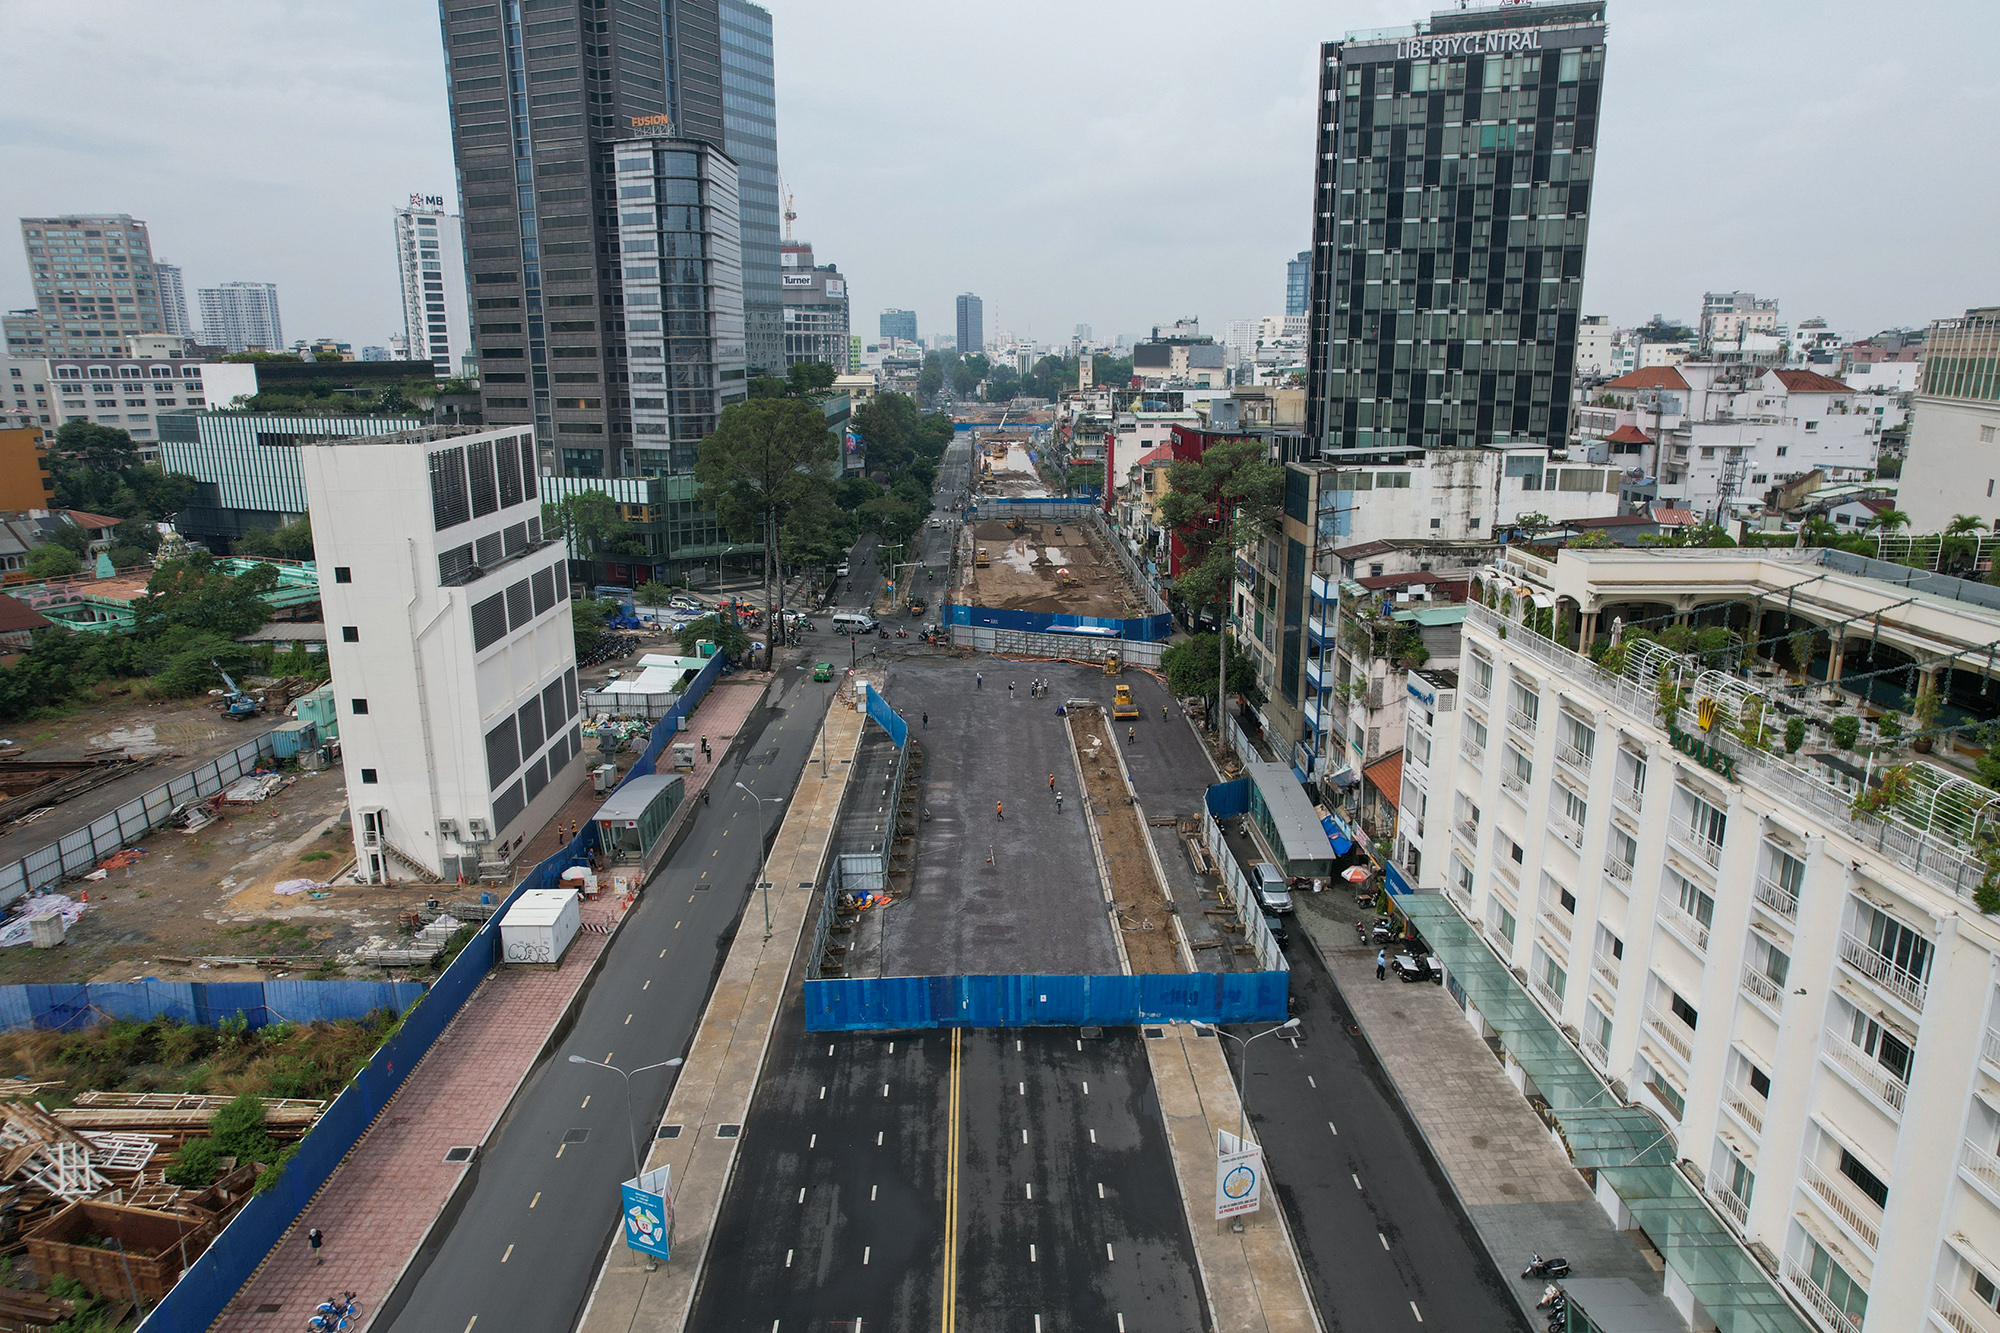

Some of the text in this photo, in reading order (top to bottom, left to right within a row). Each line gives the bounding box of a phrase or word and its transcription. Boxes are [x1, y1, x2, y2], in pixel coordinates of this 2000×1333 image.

[631, 114, 668, 127] FUSION
[425, 195, 444, 206] MB
[783, 275, 811, 285] Turner
[668, 724, 735, 782] ROLEX
